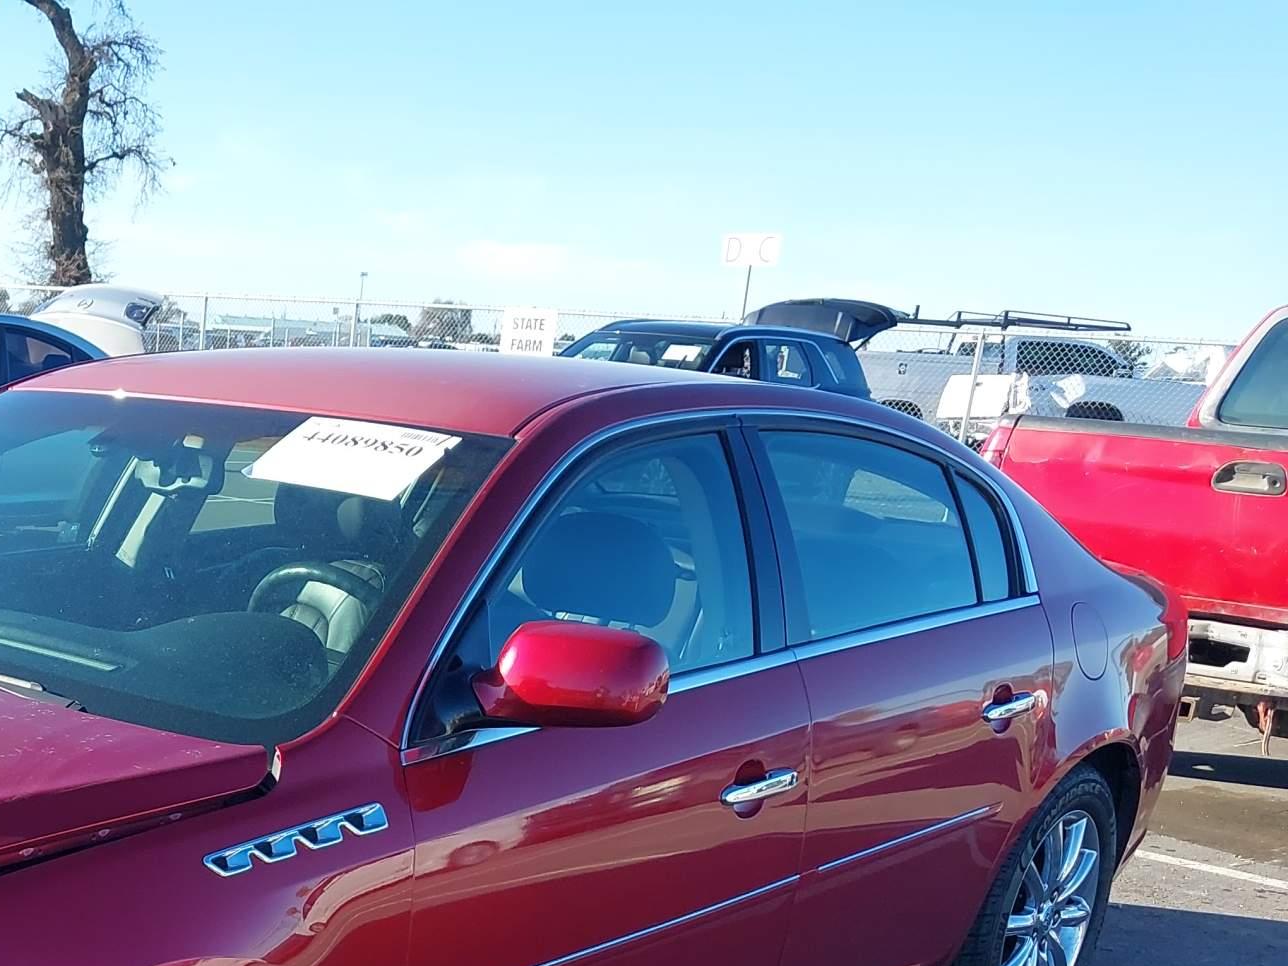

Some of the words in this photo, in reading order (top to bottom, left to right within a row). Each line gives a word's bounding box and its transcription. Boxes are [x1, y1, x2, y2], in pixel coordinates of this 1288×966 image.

[726, 237, 743, 263] D
[759, 236, 777, 263] C
[513, 317, 545, 331] STATE
[511, 338, 543, 352] FARM
[303, 431, 424, 457] 44089850
